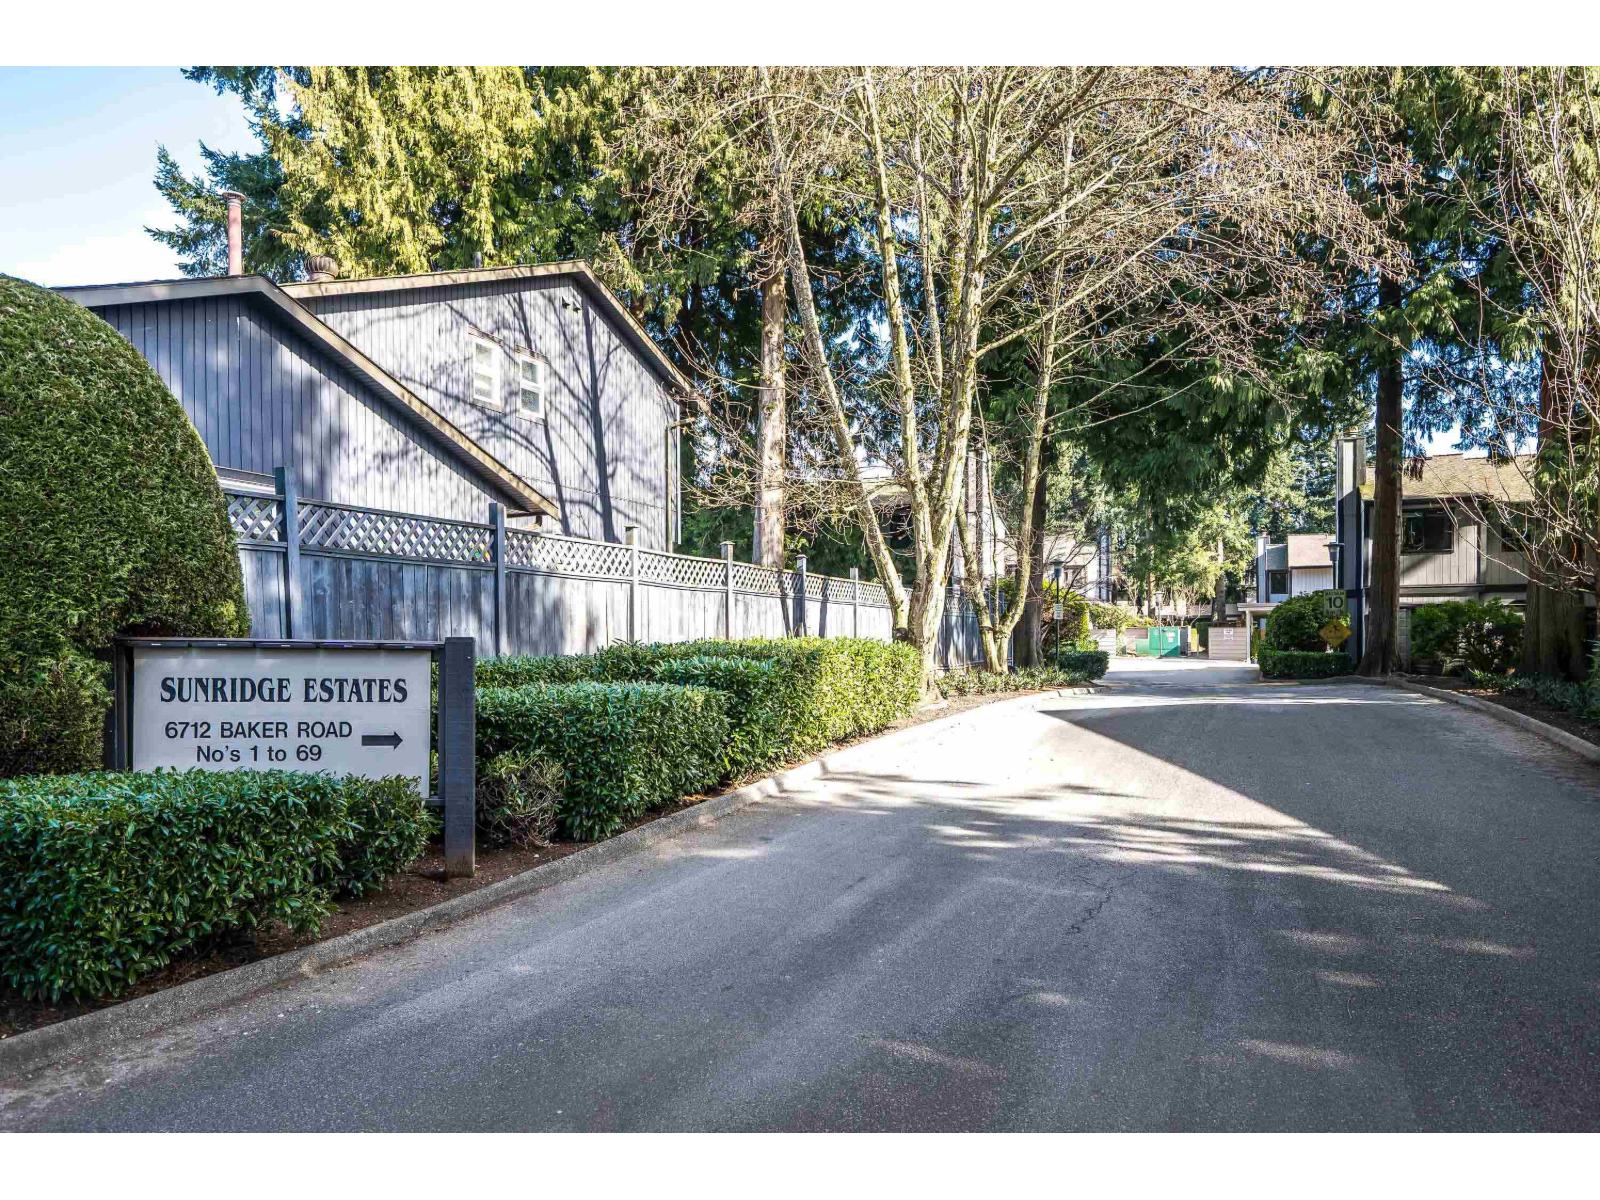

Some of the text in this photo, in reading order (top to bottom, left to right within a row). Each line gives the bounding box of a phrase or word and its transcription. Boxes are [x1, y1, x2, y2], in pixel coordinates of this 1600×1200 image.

[1328, 596, 1344, 608] 10
[161, 677, 408, 703] SUNRIDGE ESTATES
[165, 722, 353, 739] 6712 BAKER ROAD
[196, 745, 322, 762] No's 1 to 69
